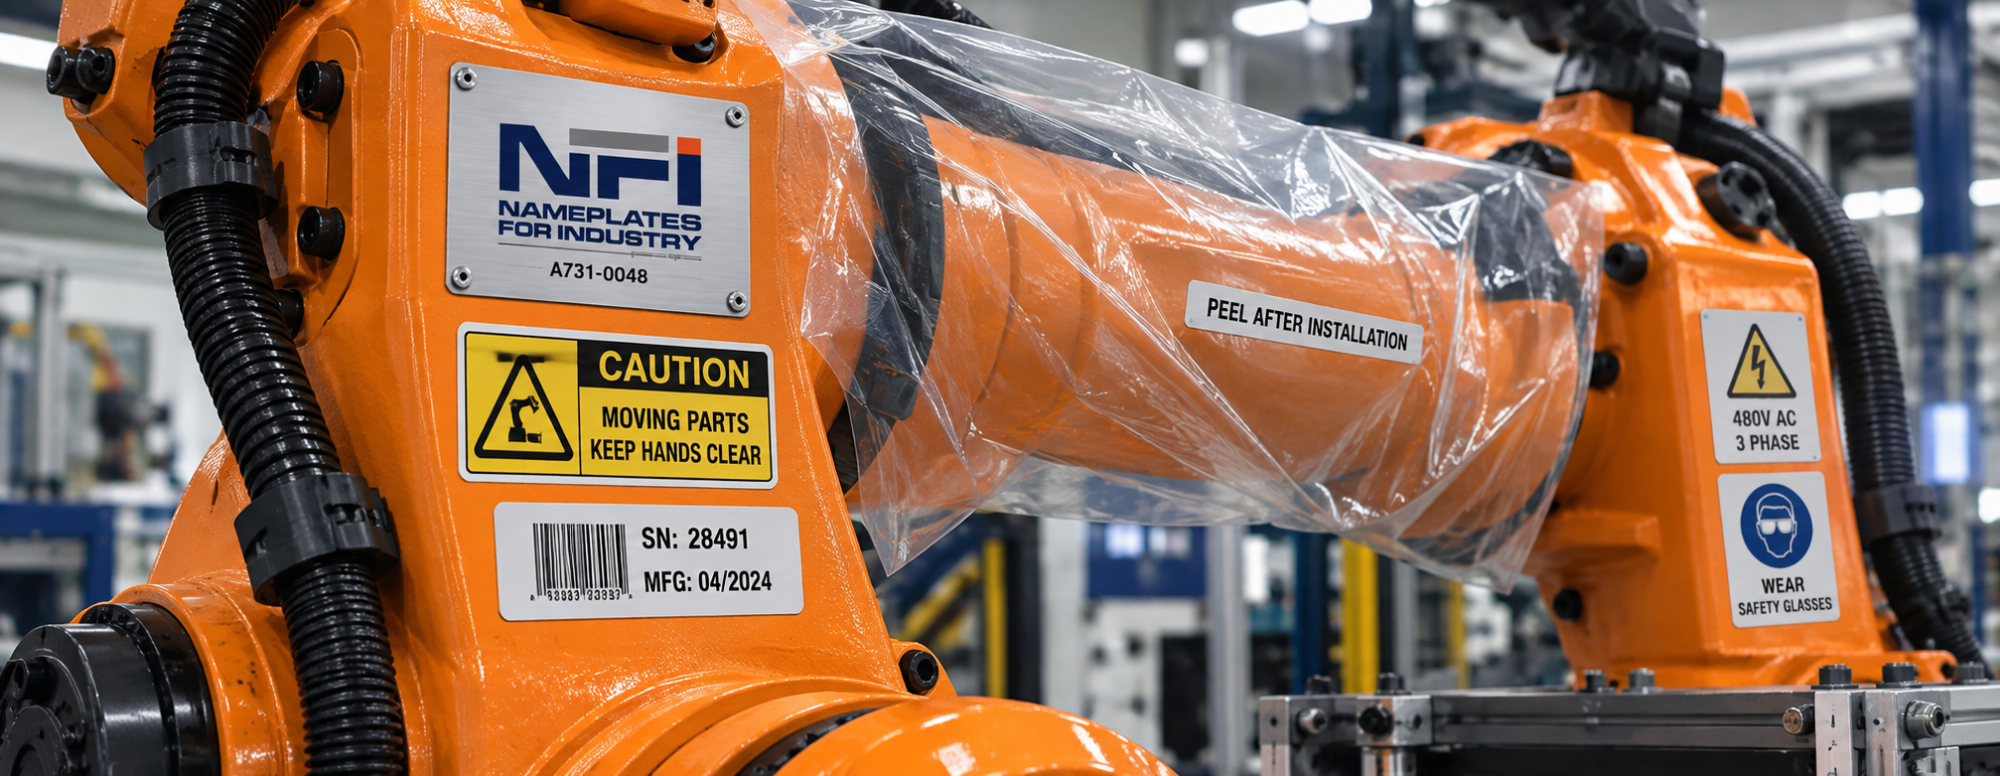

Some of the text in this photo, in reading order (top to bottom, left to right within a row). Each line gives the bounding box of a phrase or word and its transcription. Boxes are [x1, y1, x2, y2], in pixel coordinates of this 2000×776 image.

[498, 122, 702, 207] NFI
[498, 199, 702, 232] NAMEPLATES
[498, 219, 702, 251] FOR INDUSTRY
[549, 261, 648, 284] A731-0048
[1206, 297, 1408, 352] PEEL AFTER INSTALLATION
[599, 350, 749, 389] CAUTION
[602, 406, 750, 434] MOVING PARTS
[1732, 409, 1797, 428] 480V AC
[590, 438, 762, 466] KEEP HANDS CLEAR
[1736, 433, 1800, 452] 3 PHASE
[641, 526, 748, 550] SN: 28491
[643, 570, 773, 593] MFG: 04/2024
[1761, 576, 1805, 594] WEAR
[1738, 596, 1833, 616] SAFETY GLASSES
